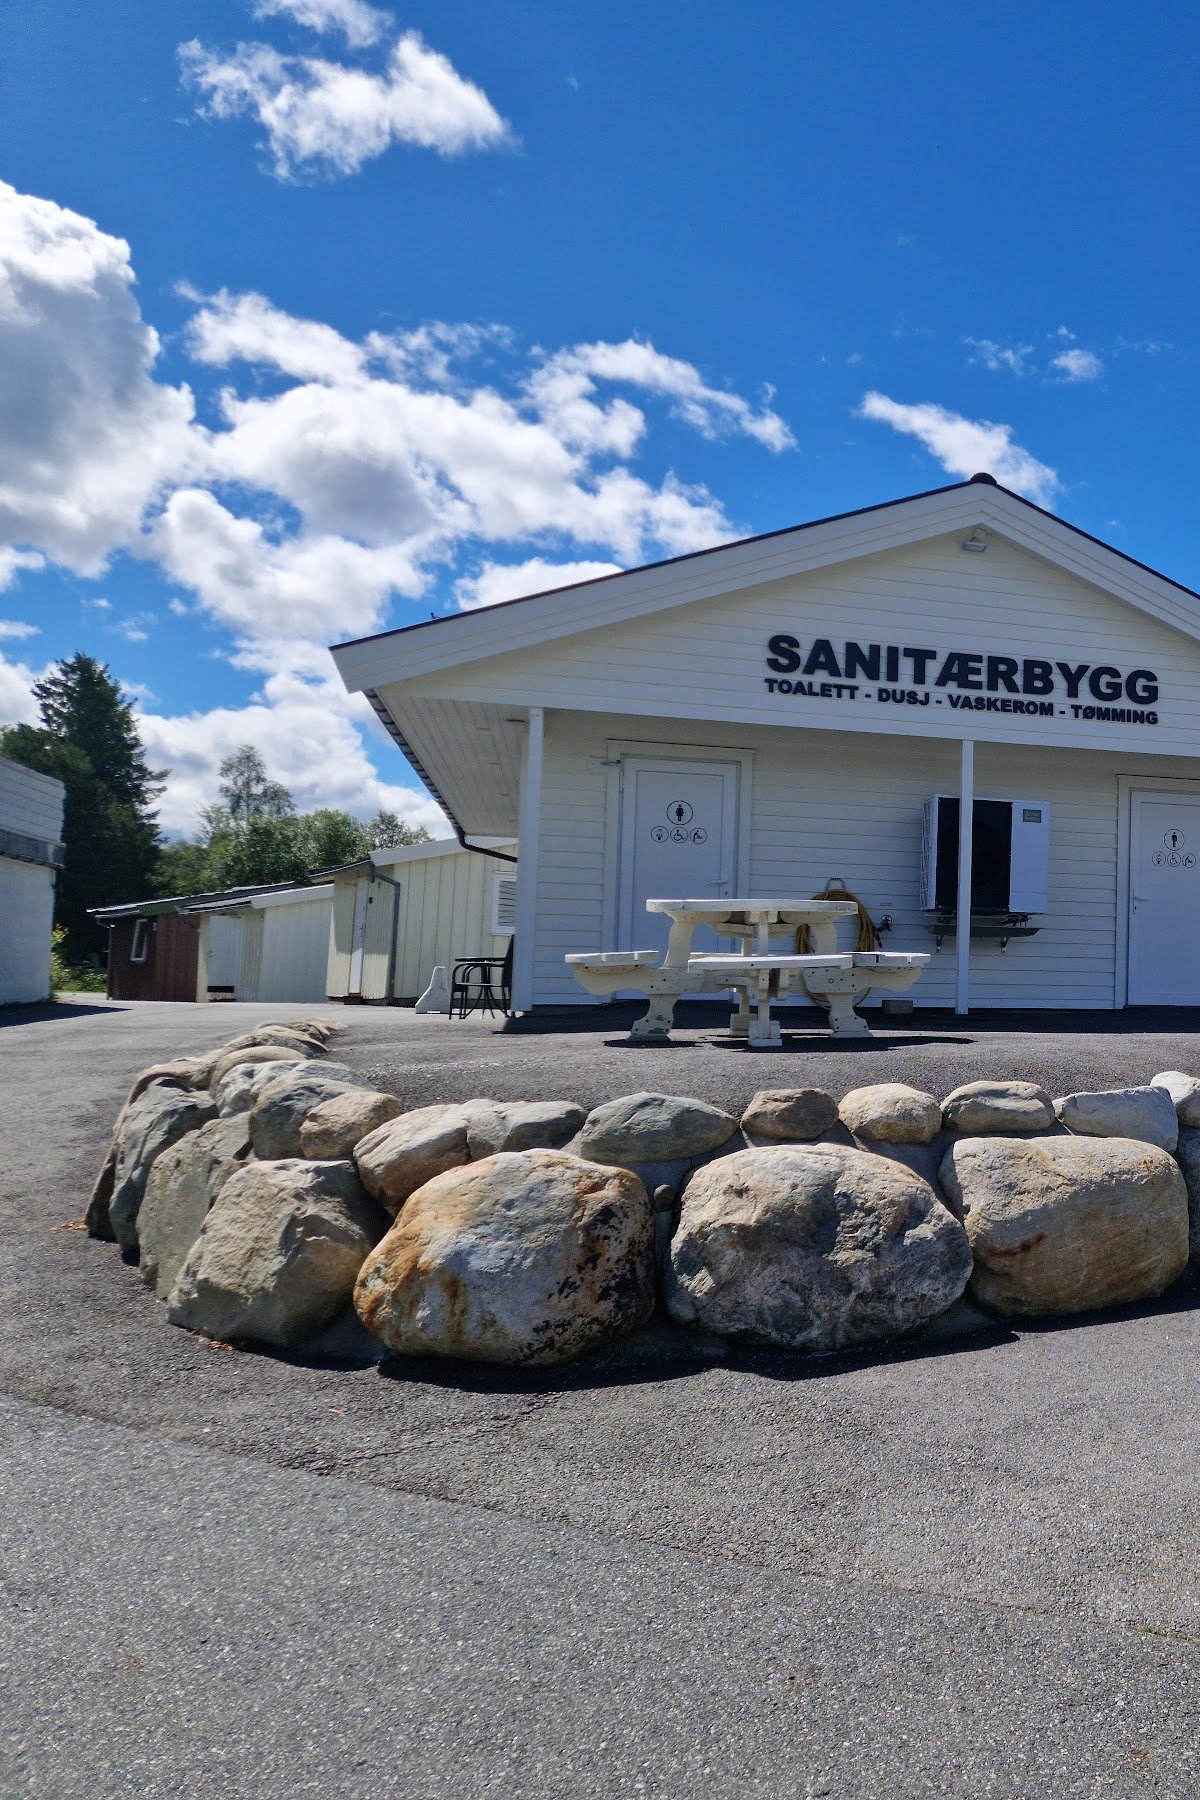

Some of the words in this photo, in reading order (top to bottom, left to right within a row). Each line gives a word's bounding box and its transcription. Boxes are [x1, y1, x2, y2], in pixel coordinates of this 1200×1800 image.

[766, 634, 1159, 705] SANITÆRBYGG
[764, 678, 859, 700] TOALETT
[877, 688, 930, 706] DUSJ
[948, 694, 1054, 717] VASKEROM
[1071, 704, 1159, 725] TØMMING
